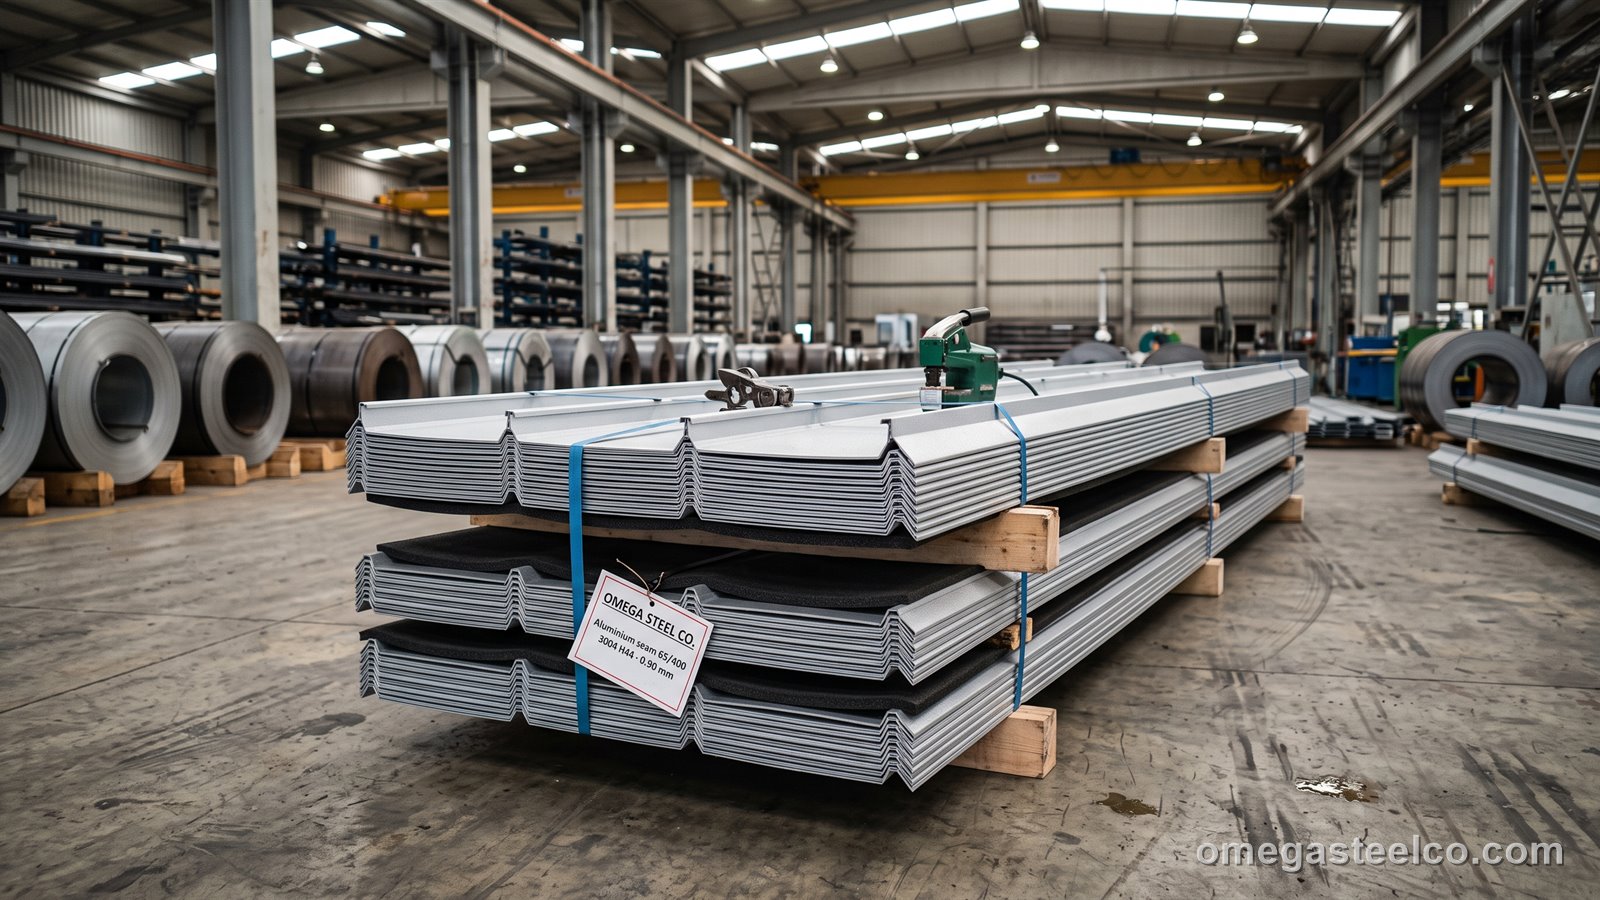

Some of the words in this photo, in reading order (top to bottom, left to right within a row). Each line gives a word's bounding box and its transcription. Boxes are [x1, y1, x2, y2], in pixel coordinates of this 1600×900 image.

[594, 618, 635, 645] Aluminium
[636, 640, 657, 656] seam
[658, 650, 687, 670] 65/400
[603, 593, 643, 620] OMEGA
[646, 613, 674, 637] STEEL
[676, 630, 695, 648] CO.
[598, 635, 618, 650] 3004
[618, 645, 635, 660] H44
[639, 656, 658, 671] 0.90
[657, 667, 674, 680] mm
